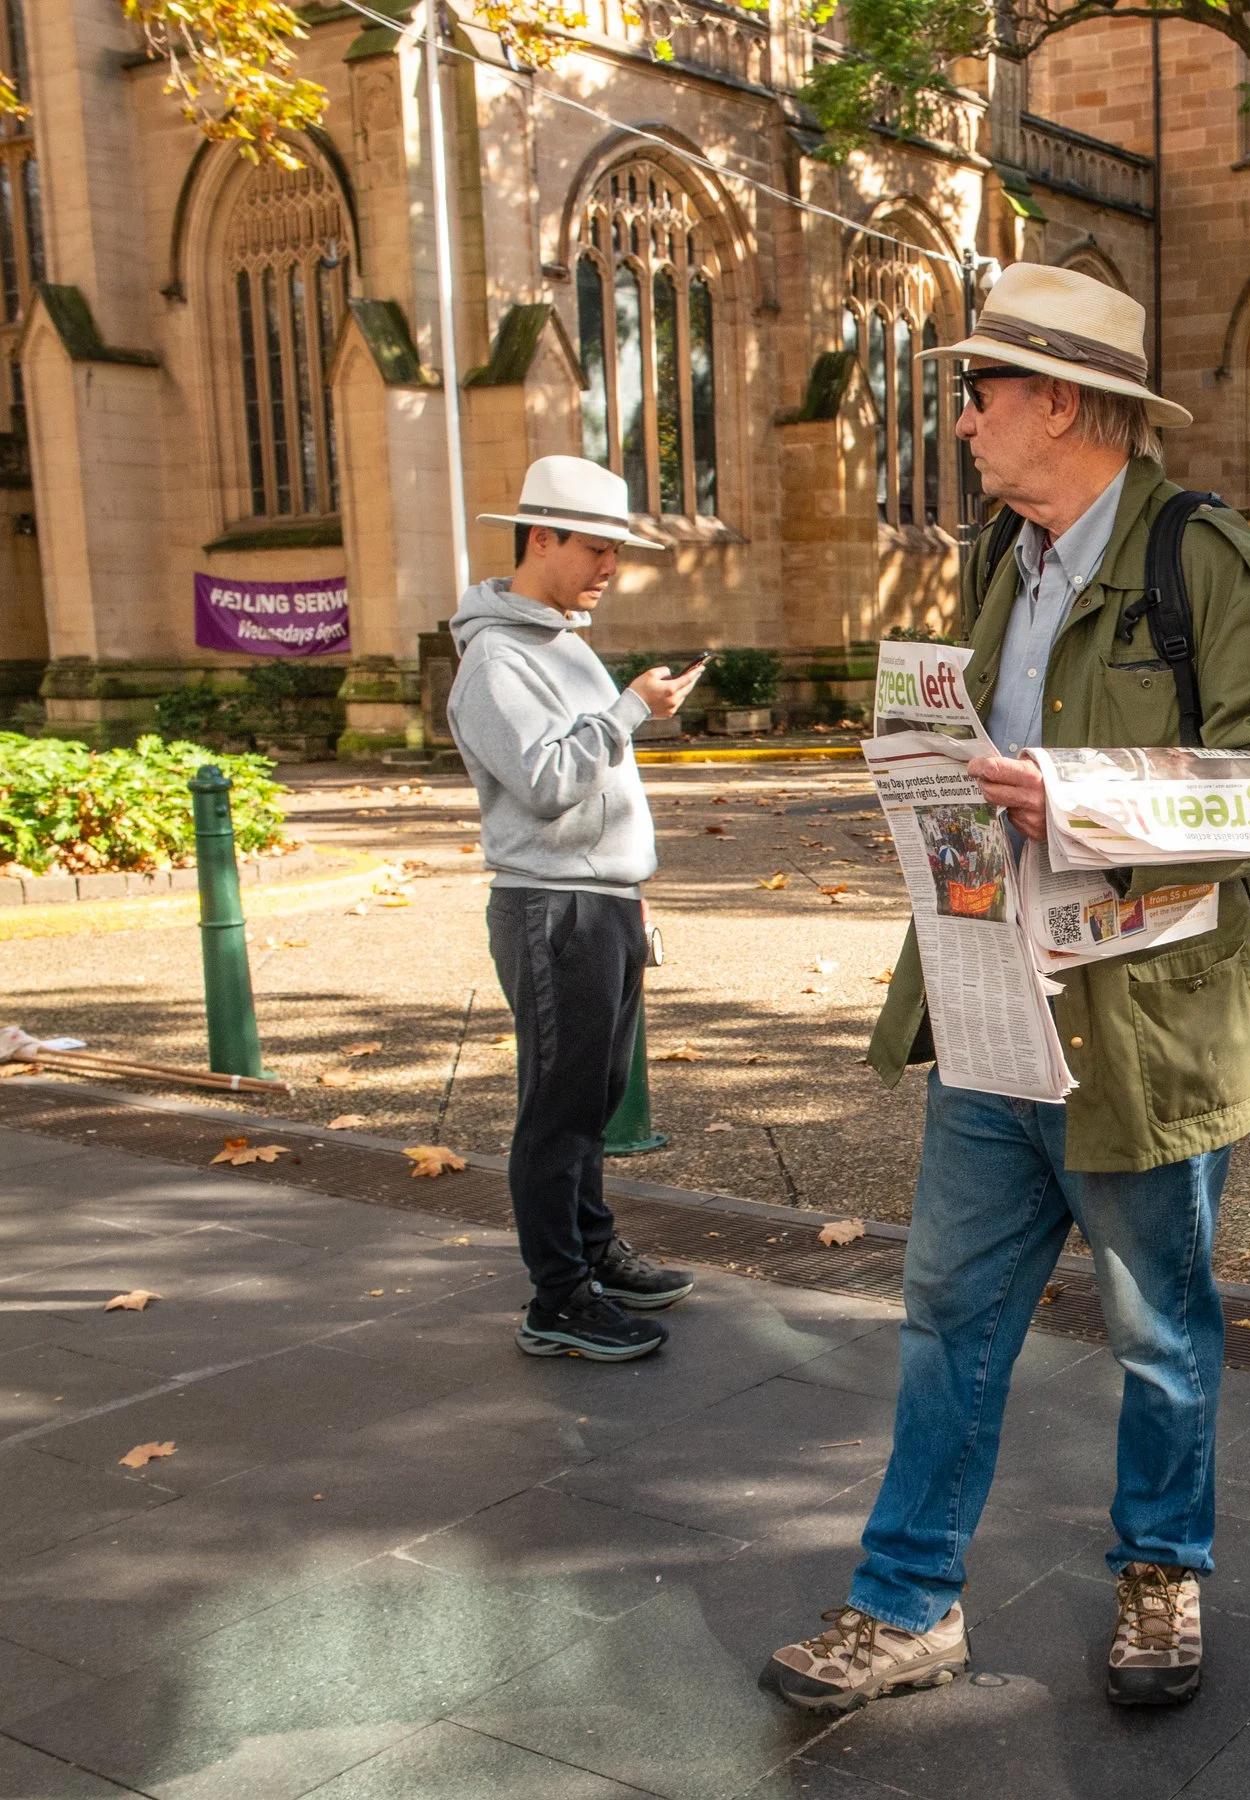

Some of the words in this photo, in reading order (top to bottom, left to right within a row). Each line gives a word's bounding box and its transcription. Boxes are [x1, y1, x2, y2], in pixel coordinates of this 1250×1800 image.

[877, 669, 920, 713] green
[919, 660, 965, 710] left
[876, 779, 891, 791] May
[891, 778, 905, 791] Day
[905, 775, 935, 789] protests
[935, 772, 962, 784] demand
[880, 790, 915, 803] immigrant
[915, 788, 940, 801] rights,
[940, 786, 972, 798] denounce
[1185, 831, 1211, 840] action
[1149, 895, 1168, 905] from
[1170, 890, 1180, 901] $5
[1188, 885, 1209, 896] month
[1149, 909, 1159, 919] get
[1160, 907, 1170, 915] the
